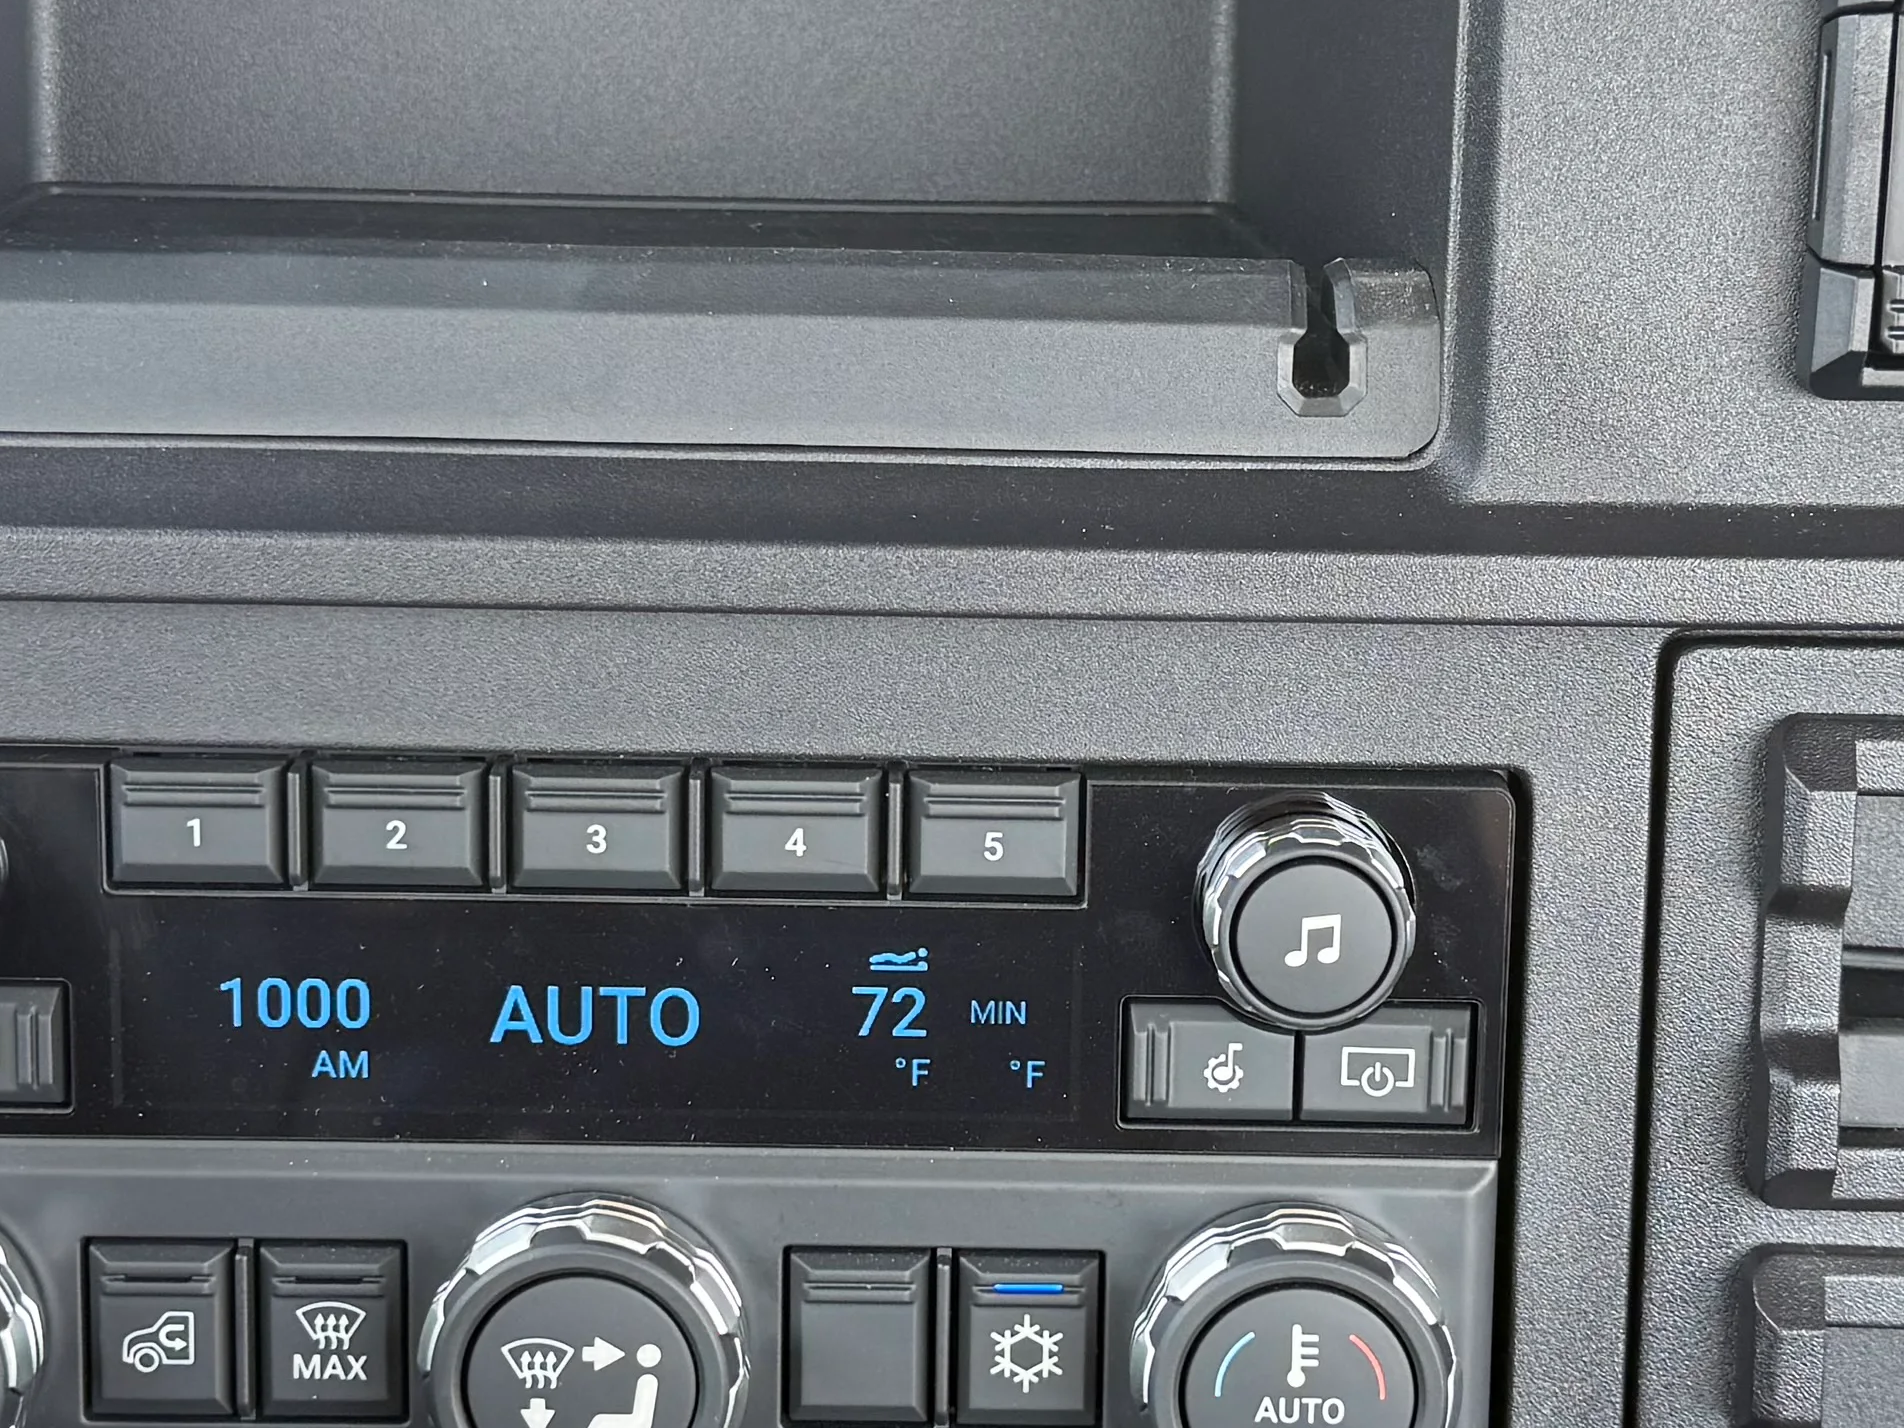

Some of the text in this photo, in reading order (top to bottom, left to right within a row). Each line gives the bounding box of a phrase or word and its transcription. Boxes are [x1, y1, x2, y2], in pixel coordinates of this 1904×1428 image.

[185, 818, 201, 848] 1
[385, 819, 408, 850] 2
[586, 824, 607, 854] 3
[784, 827, 807, 857] 4
[983, 831, 1004, 862] 5
[219, 977, 371, 1030] 1000
[489, 984, 701, 1048] AUTO
[851, 986, 928, 1039] 72
[970, 999, 1027, 1026] MIN
[311, 1049, 369, 1080] AM
[895, 1055, 931, 1088] °F
[1009, 1058, 1046, 1090] °F
[292, 1354, 368, 1382] MAX
[1253, 1396, 1346, 1425] AUTO
